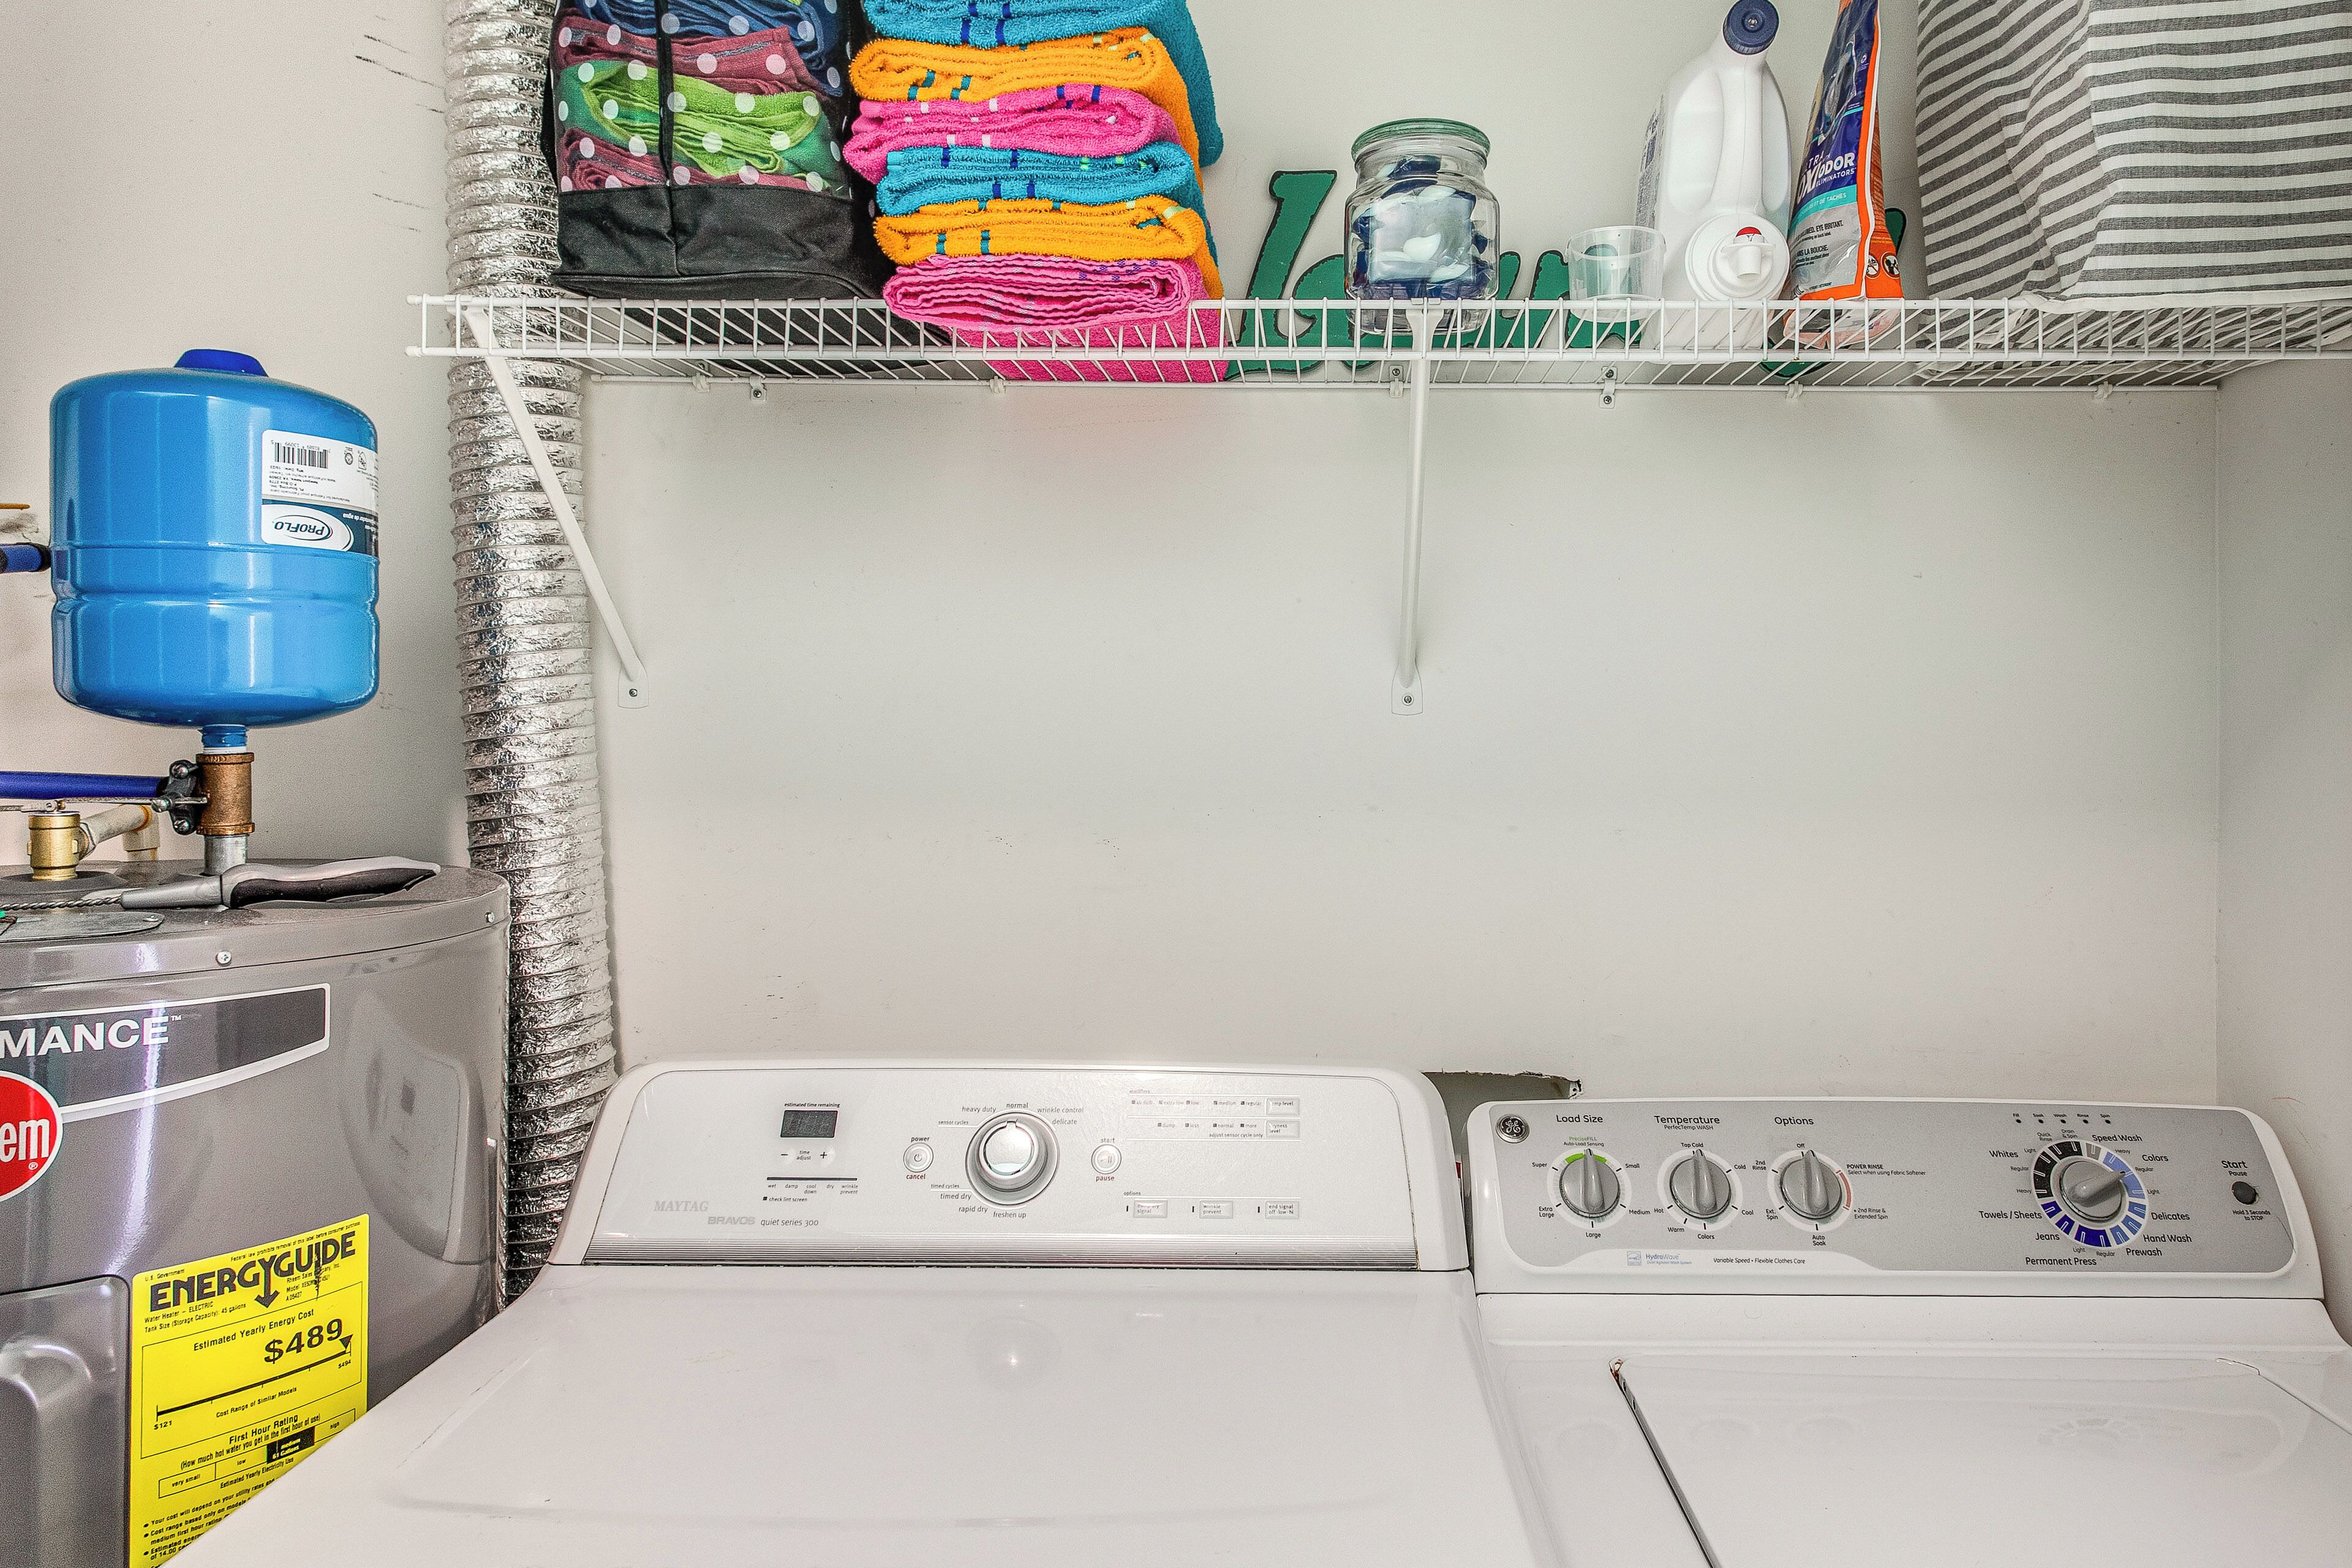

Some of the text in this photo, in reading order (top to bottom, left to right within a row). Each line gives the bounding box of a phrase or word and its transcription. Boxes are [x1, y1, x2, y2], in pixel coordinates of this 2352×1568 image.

[1819, 153, 1855, 178] ODOR
[1816, 169, 1854, 187] ELIMINATORS
[274, 522, 325, 535] PROFLO
[1654, 1116, 1720, 1125] Temperature
[1774, 1117, 1814, 1126] Options
[654, 1201, 709, 1212] MAYTAG
[150, 1231, 355, 1311] ENERGYGUIDE
[172, 1317, 193, 1328] (Storage
[230, 1303, 246, 1312] gallons
[189, 1302, 213, 1312] ELECTRIC
[194, 1309, 314, 1351] Estimated Yearly Energy Cost
[265, 1319, 342, 1363] $489
[338, 1360, 351, 1369] $494
[231, 1404, 248, 1413] Range
[258, 1395, 276, 1404] Similar
[279, 1387, 296, 1396] Models
[154, 1420, 172, 1430] $121
[230, 1414, 298, 1444] First Hour Rating
[186, 1474, 200, 1483] small
[221, 1476, 244, 1488] Estimated
[246, 1468, 260, 1480] Yearly
[262, 1460, 284, 1474] Electricity
